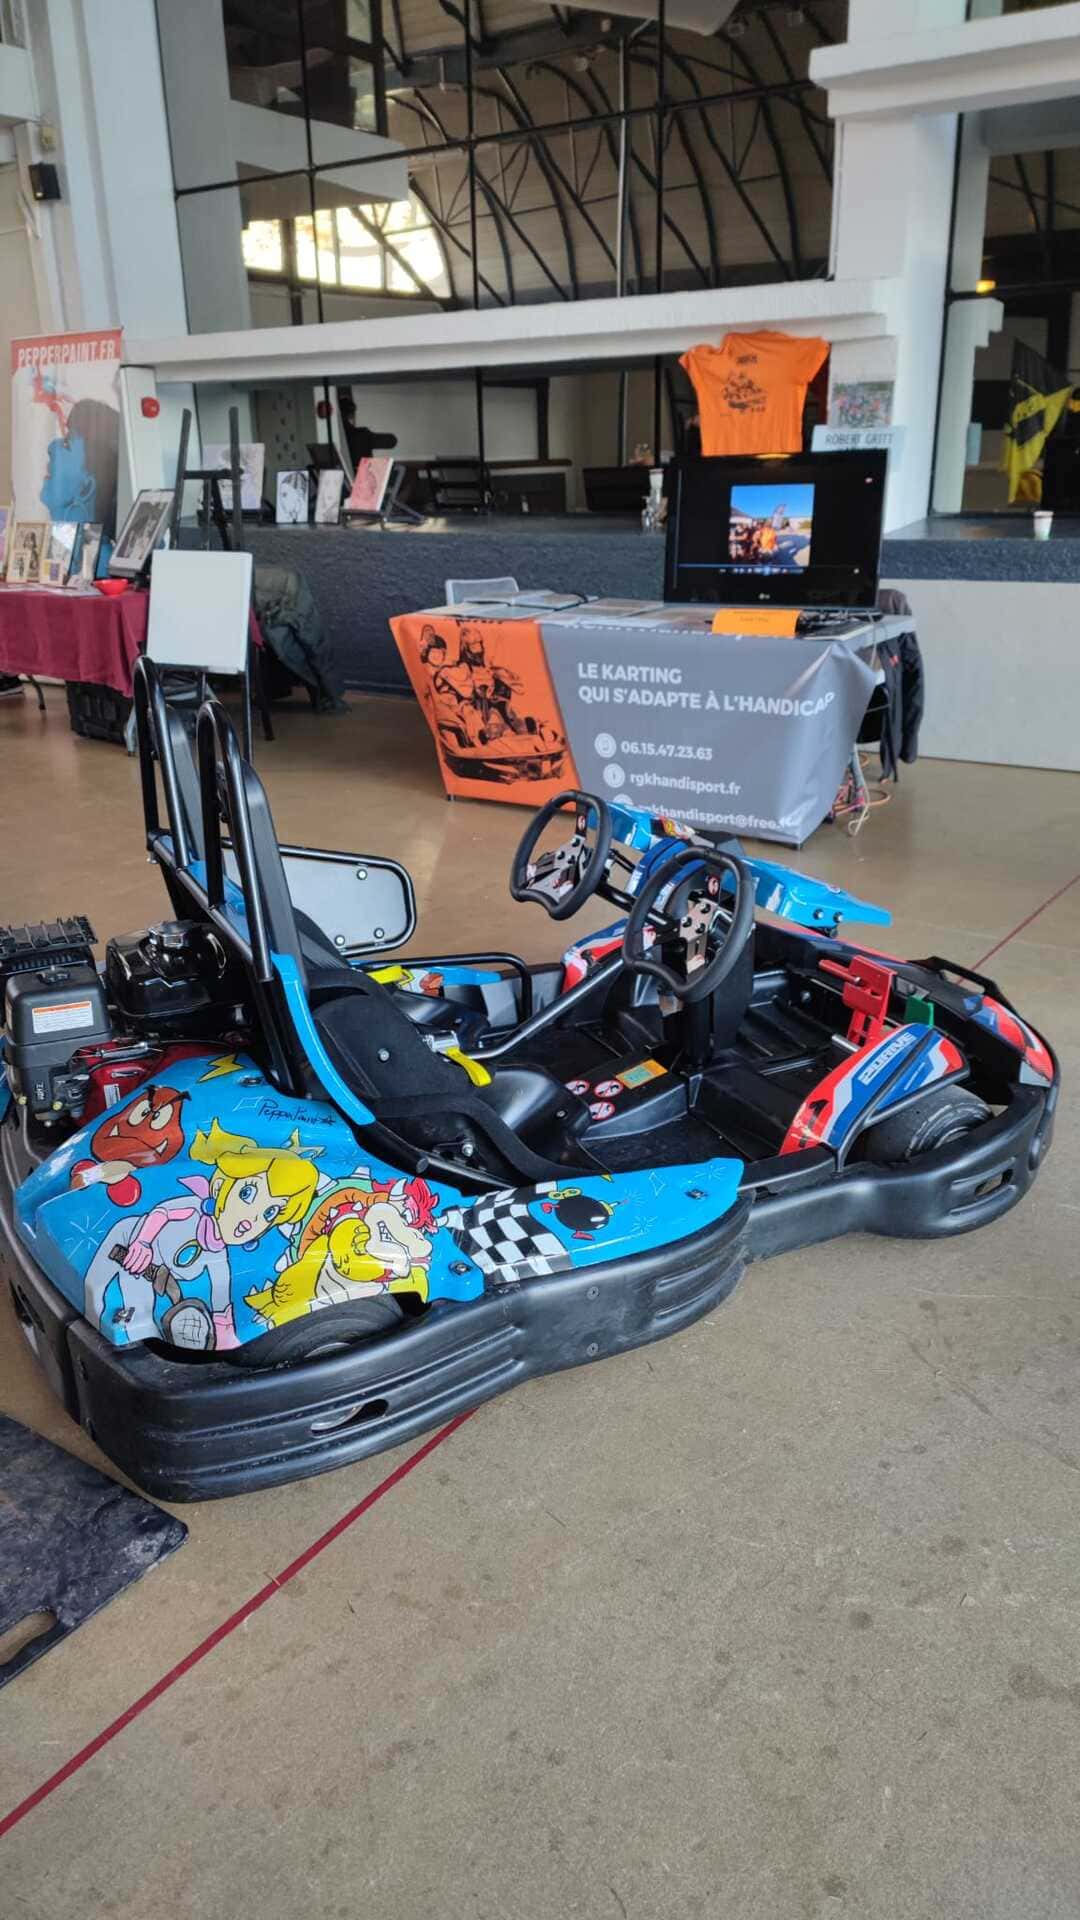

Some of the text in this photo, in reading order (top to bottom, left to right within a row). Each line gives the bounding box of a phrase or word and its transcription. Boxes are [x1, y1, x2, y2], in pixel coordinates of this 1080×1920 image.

[17, 339, 116, 369] PEPPERPAINT.FR
[578, 661, 683, 685] LE KARTING
[578, 685, 835, 717] QUI S'ADAPTE À L'HANDICAP
[620, 740, 714, 761] 06.15.47.23.63
[629, 772, 742, 796] rgkhandisport.fr
